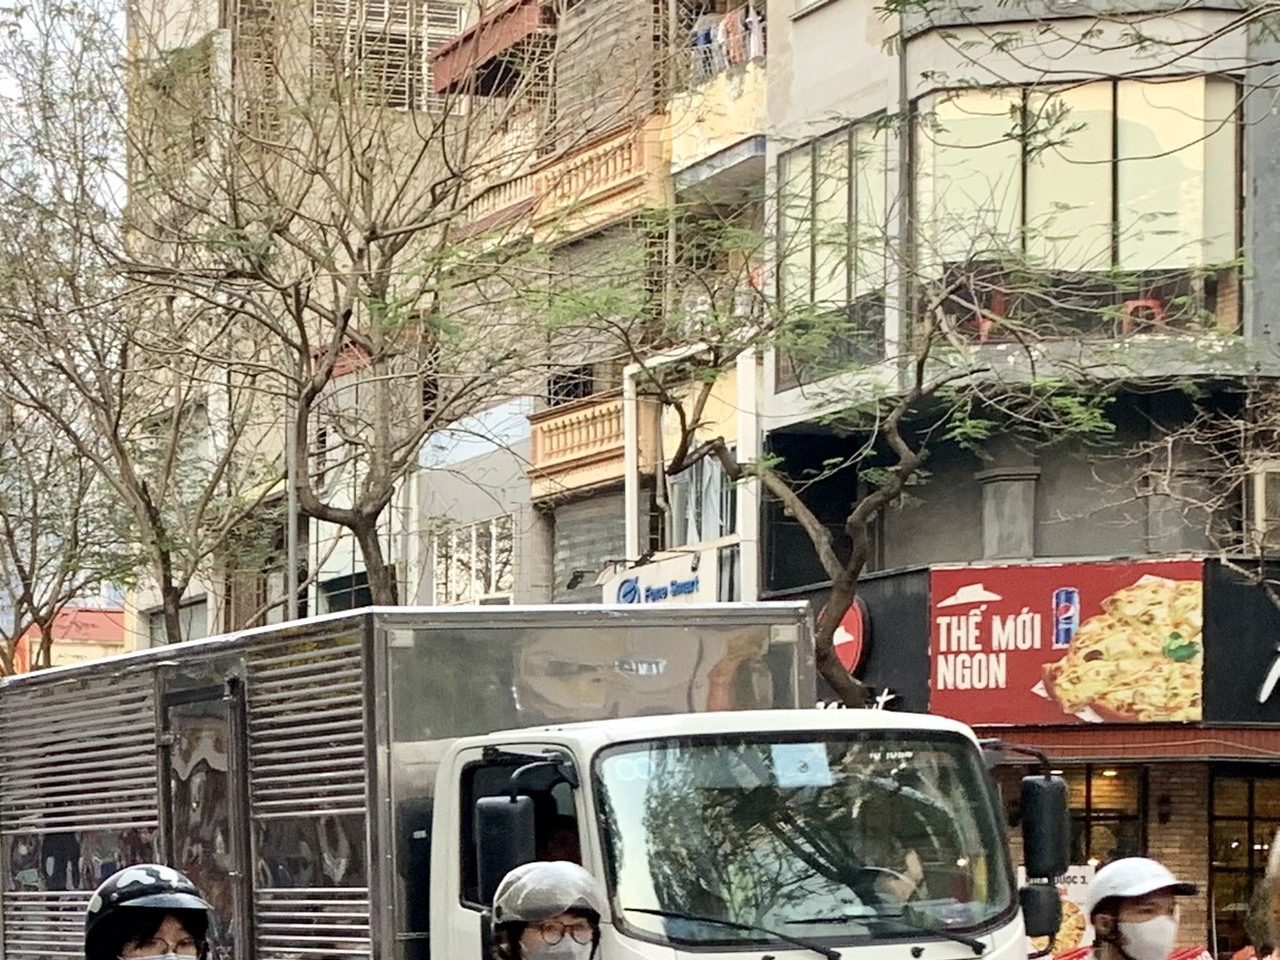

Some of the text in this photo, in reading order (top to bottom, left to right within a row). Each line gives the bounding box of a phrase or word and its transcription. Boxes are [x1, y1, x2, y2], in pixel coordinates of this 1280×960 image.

[936, 604, 1041, 652] THẾ MỚI
[937, 652, 1007, 690] NGON
